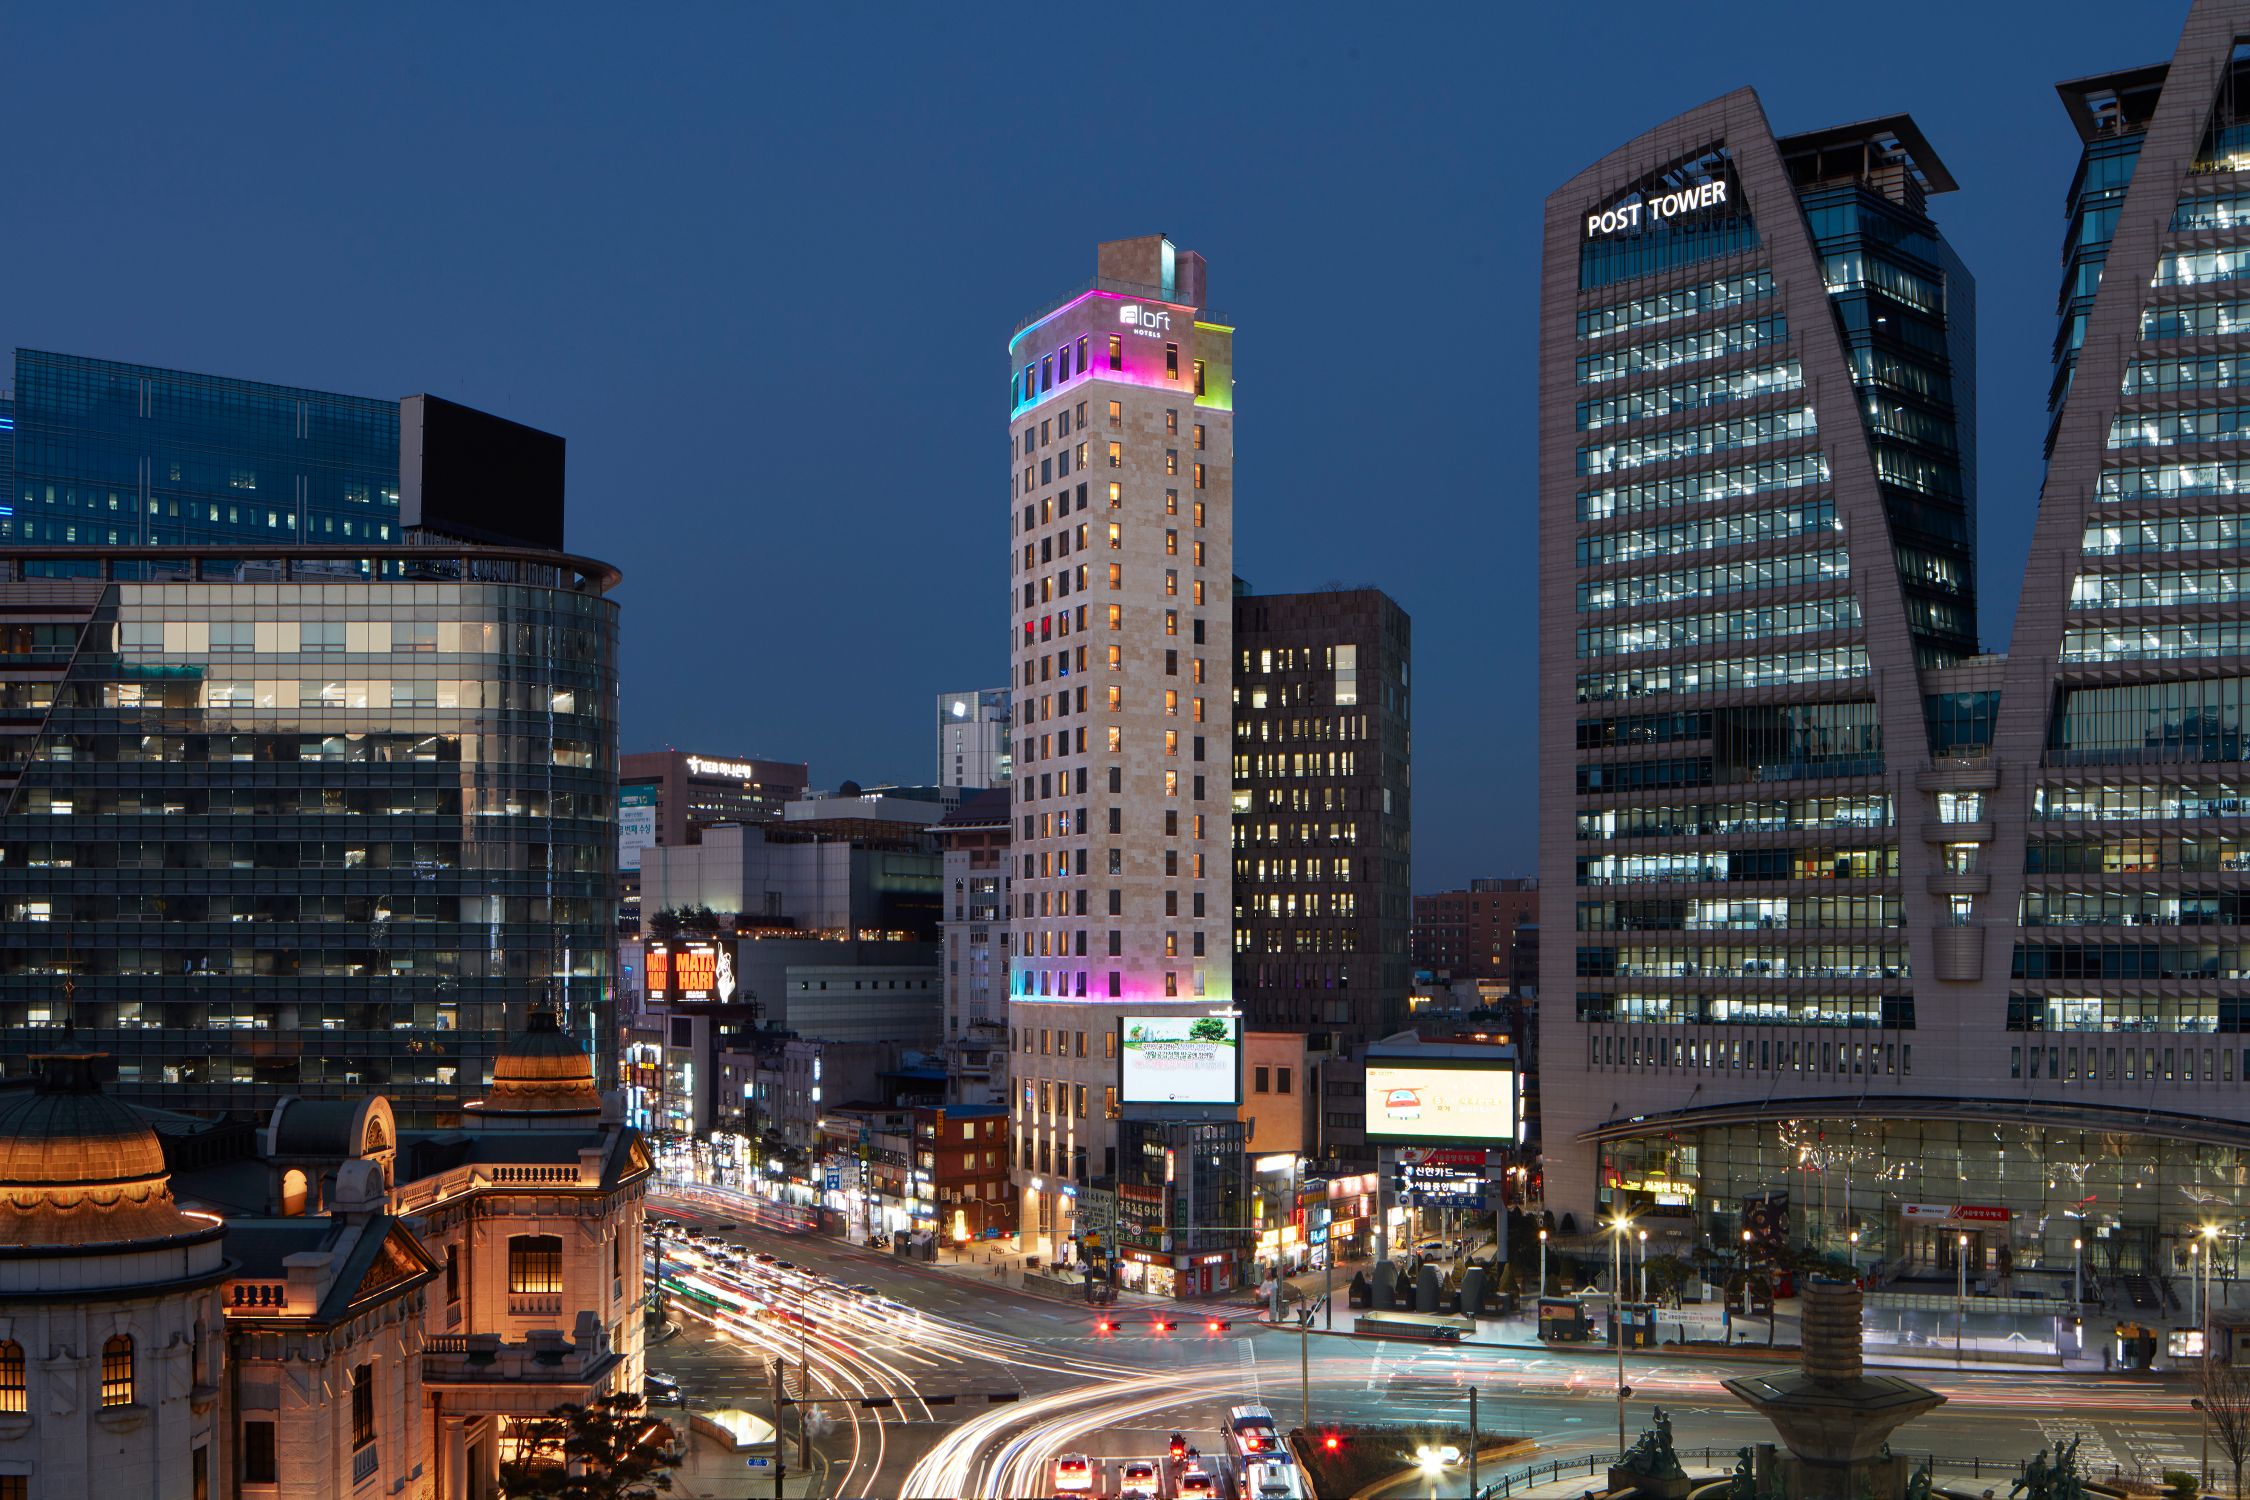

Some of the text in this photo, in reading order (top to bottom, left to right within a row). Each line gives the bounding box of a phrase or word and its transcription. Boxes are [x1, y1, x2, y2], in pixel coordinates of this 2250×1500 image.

[1588, 181, 1726, 238] POST TOWER
[1120, 305, 1170, 330] aloft
[1134, 328, 1161, 338] HOTELS
[701, 761, 751, 778] KEB 하나은행
[647, 954, 667, 971] MATA
[676, 954, 715, 971] MATA
[648, 972, 667, 989] HARI
[679, 972, 713, 989] HARI
[1415, 1166, 1454, 1177] 신한카드
